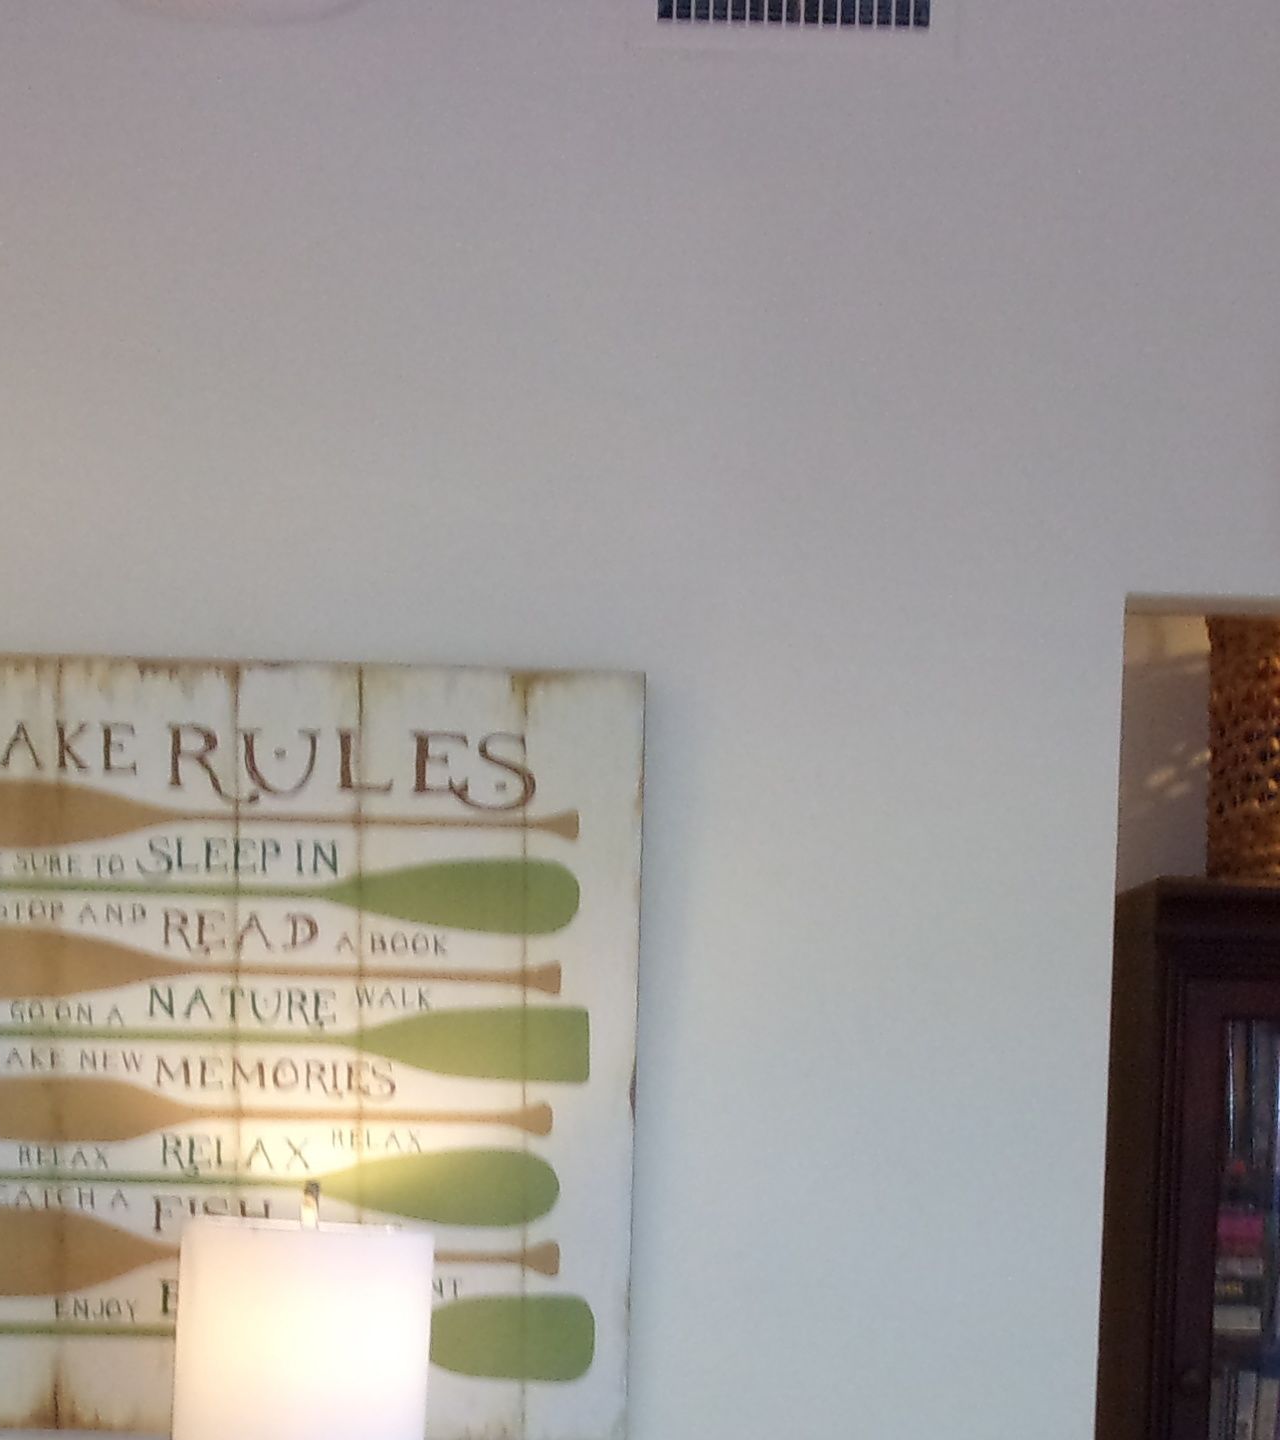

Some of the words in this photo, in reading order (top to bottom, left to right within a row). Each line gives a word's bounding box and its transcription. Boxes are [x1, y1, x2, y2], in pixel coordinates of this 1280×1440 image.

[167, 720, 537, 811] RULES
[15, 852, 83, 877] SURE
[95, 853, 126, 879] TO
[135, 834, 282, 880] SLEEP
[294, 837, 341, 878] IN
[78, 901, 148, 926] AND
[162, 907, 320, 956] READ
[334, 931, 356, 954] A
[369, 931, 450, 957] BOOK
[8, 1001, 45, 1025] GO
[55, 1000, 95, 1026] ON
[105, 1003, 126, 1028] A
[147, 984, 338, 1029] NATURE
[353, 984, 434, 1012] WALK
[78, 1049, 144, 1075] NEW
[154, 1053, 399, 1098] MEMORIES
[18, 1143, 110, 1171] RELAX
[160, 1131, 312, 1176] RELAX
[330, 1128, 422, 1154] RELAX
[109, 1187, 129, 1210] A
[53, 1296, 138, 1323] ENJOY
